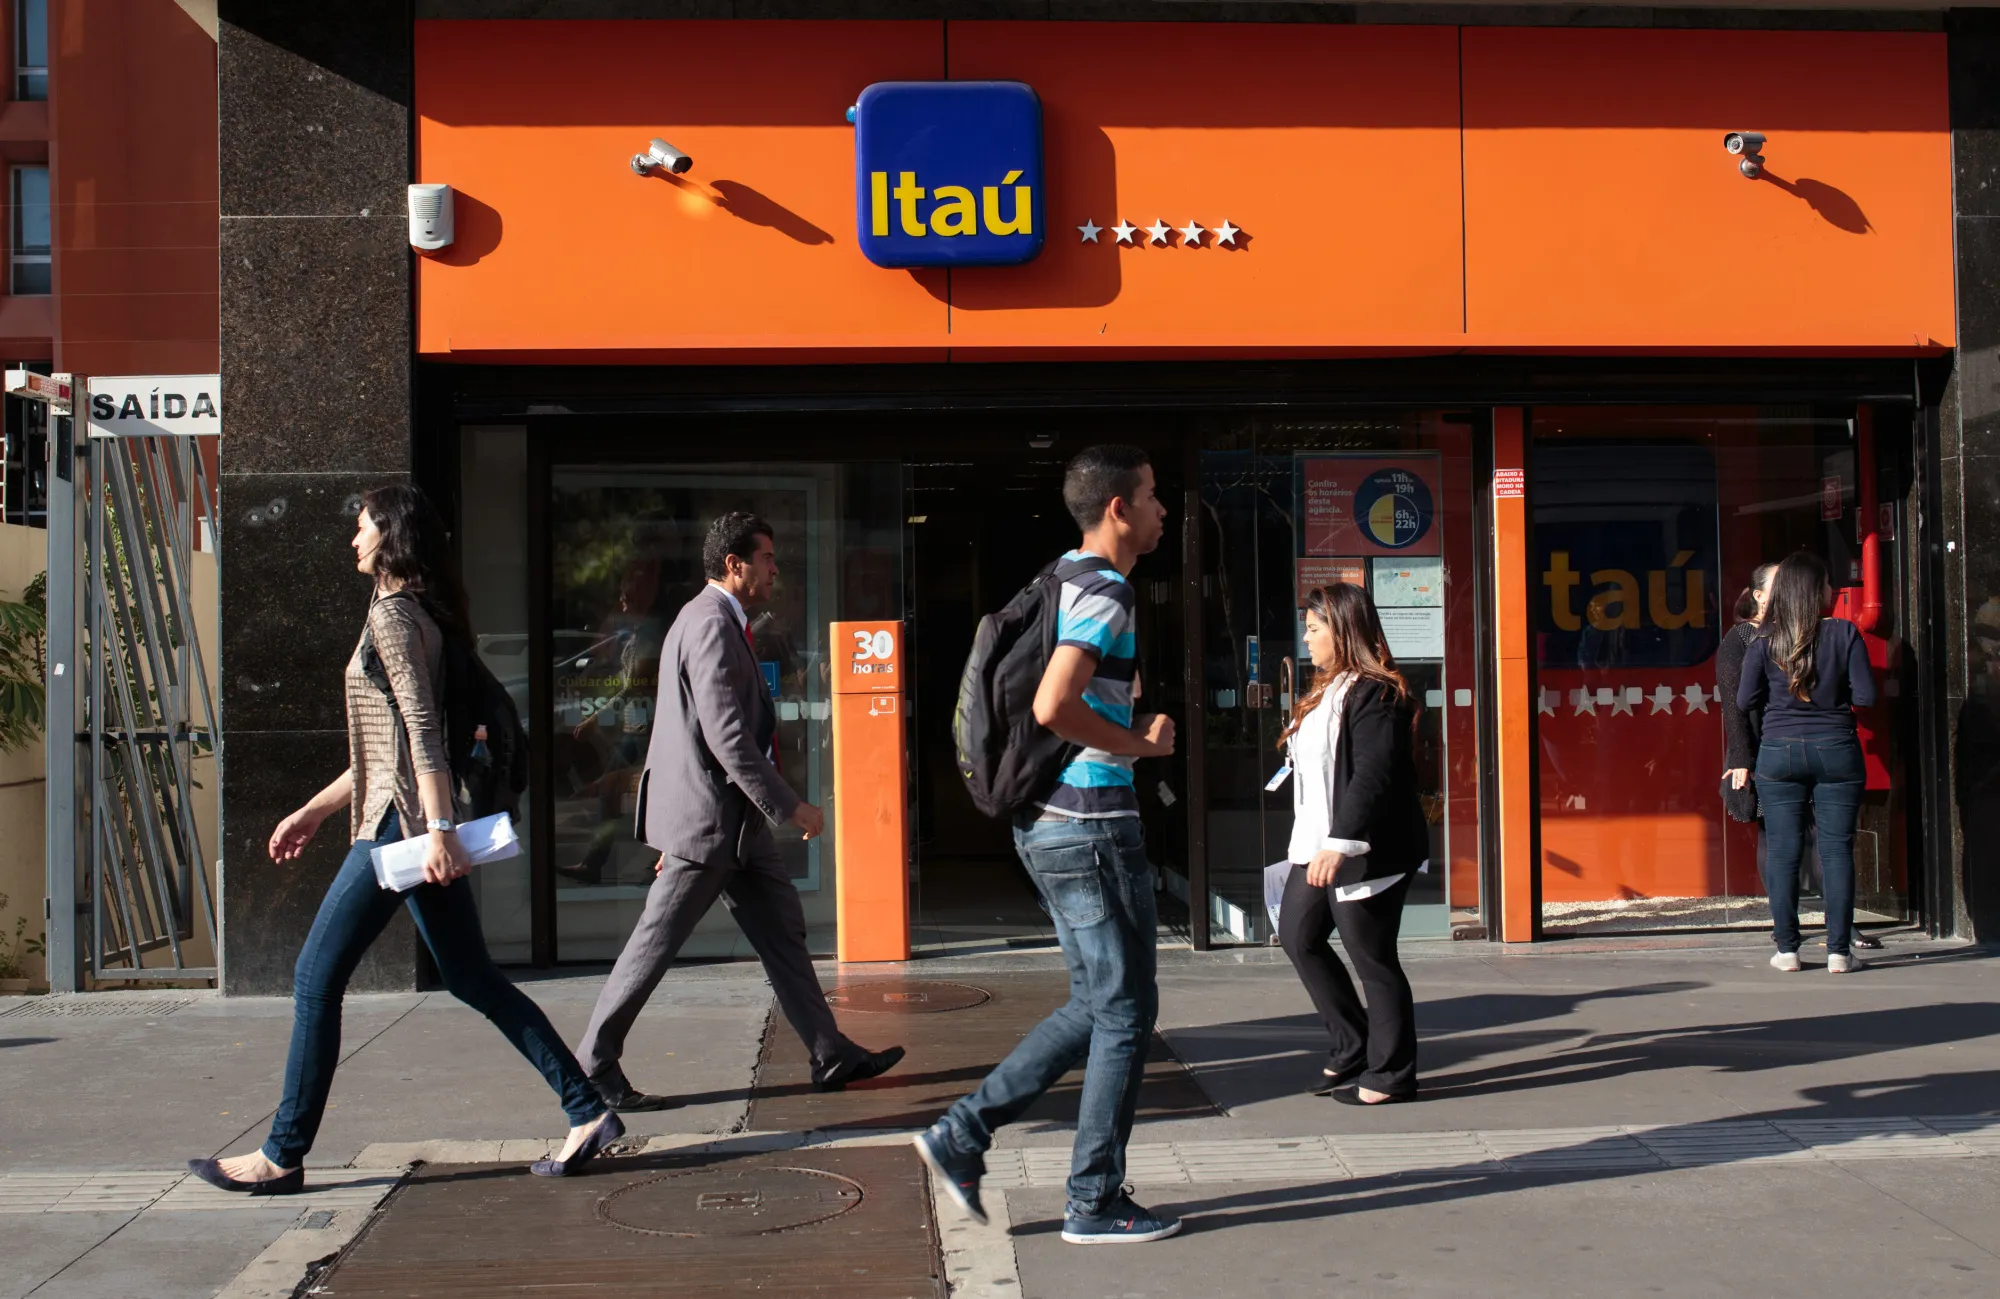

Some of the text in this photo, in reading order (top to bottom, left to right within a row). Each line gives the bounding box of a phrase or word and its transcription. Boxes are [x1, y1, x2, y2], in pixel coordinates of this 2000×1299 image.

[871, 170, 1032, 237] Itaú
[92, 387, 218, 420] SAÍDA
[1391, 473, 1409, 483] 11h
[1308, 480, 1337, 489] Confira
[1395, 484, 1414, 493] 19h
[1318, 488, 1353, 497] horários
[1308, 506, 1342, 516] agência.
[1395, 510, 1409, 519] 6h
[1395, 520, 1416, 529] 22h
[1543, 550, 1706, 631] taú
[852, 630, 894, 660] 30
[852, 660, 894, 674] horas
[557, 675, 601, 687] Cuidar
[604, 674, 621, 687] do
[623, 677, 648, 689] que
